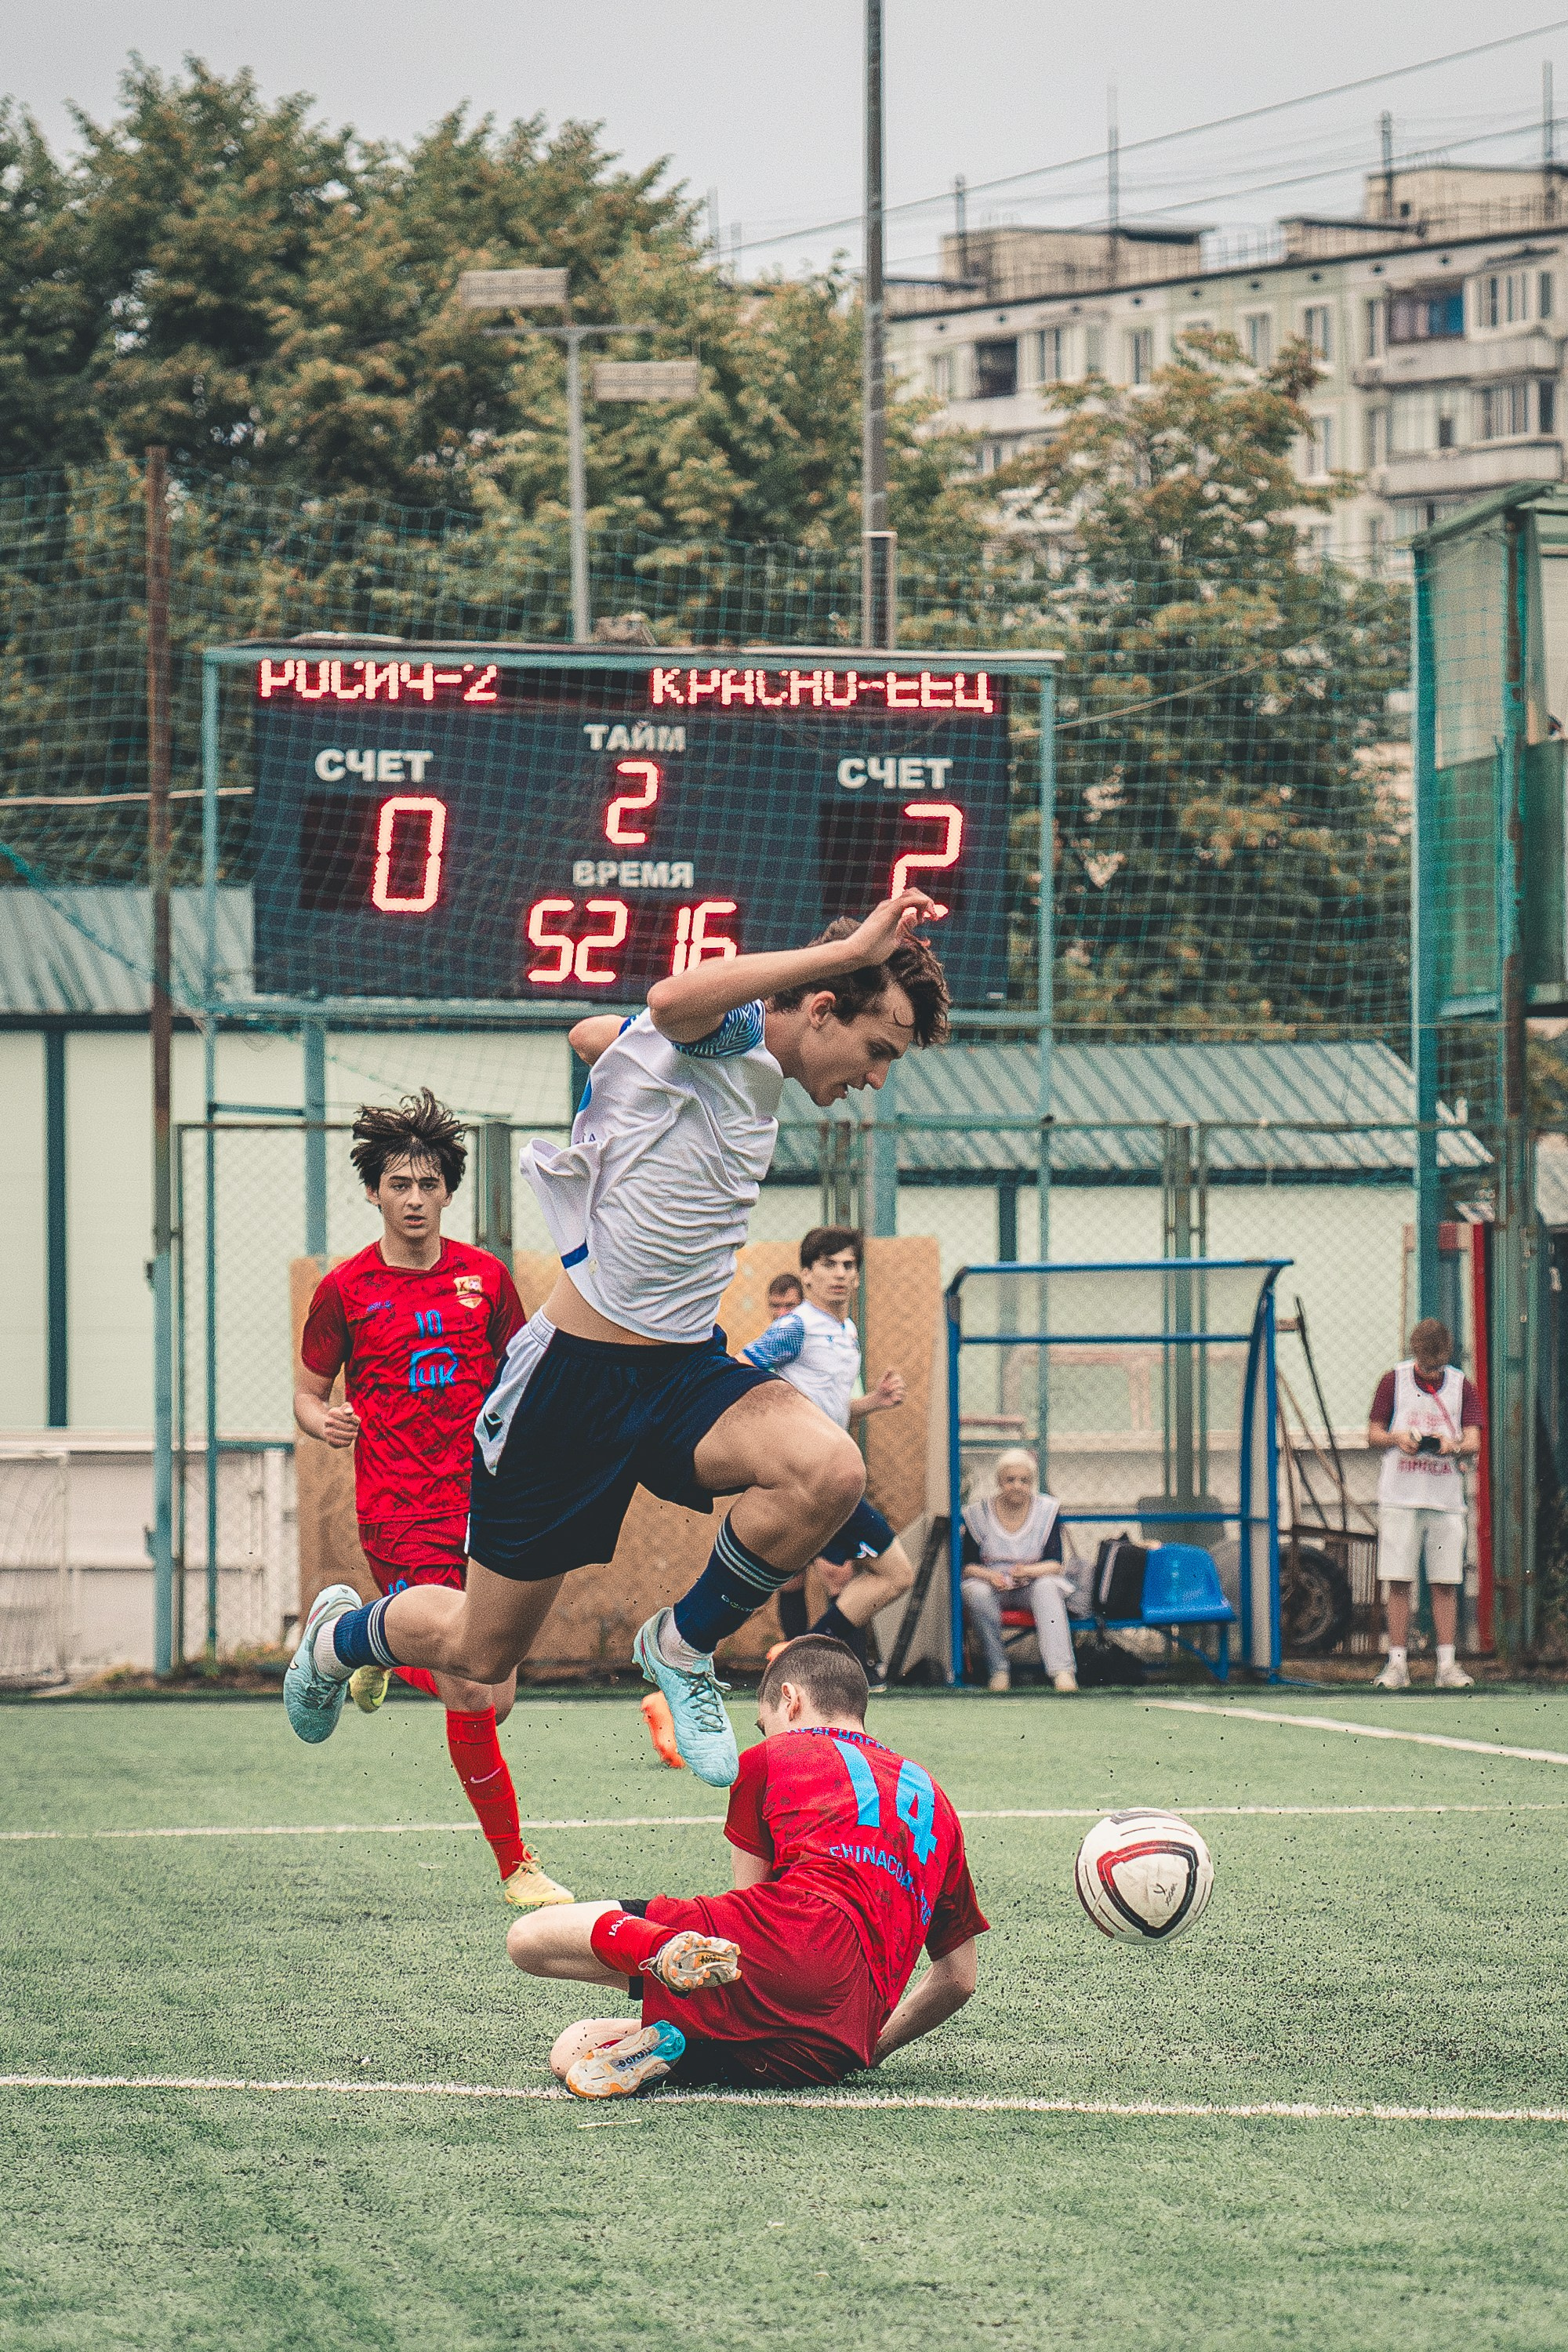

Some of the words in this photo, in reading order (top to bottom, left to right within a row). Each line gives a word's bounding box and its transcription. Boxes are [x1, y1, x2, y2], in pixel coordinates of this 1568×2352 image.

[314, 749, 434, 782] СЧЕТ
[583, 720, 687, 753] ТАЙМ
[605, 760, 659, 844] 2
[837, 757, 953, 789] СЧЕТ
[372, 797, 447, 913] 0
[572, 861, 695, 887] ВРЕМЯ
[891, 803, 964, 919] 2
[528, 899, 628, 984] 52
[672, 902, 738, 976] 16
[415, 1309, 443, 1338] 10
[832, 1737, 938, 1866] 14
